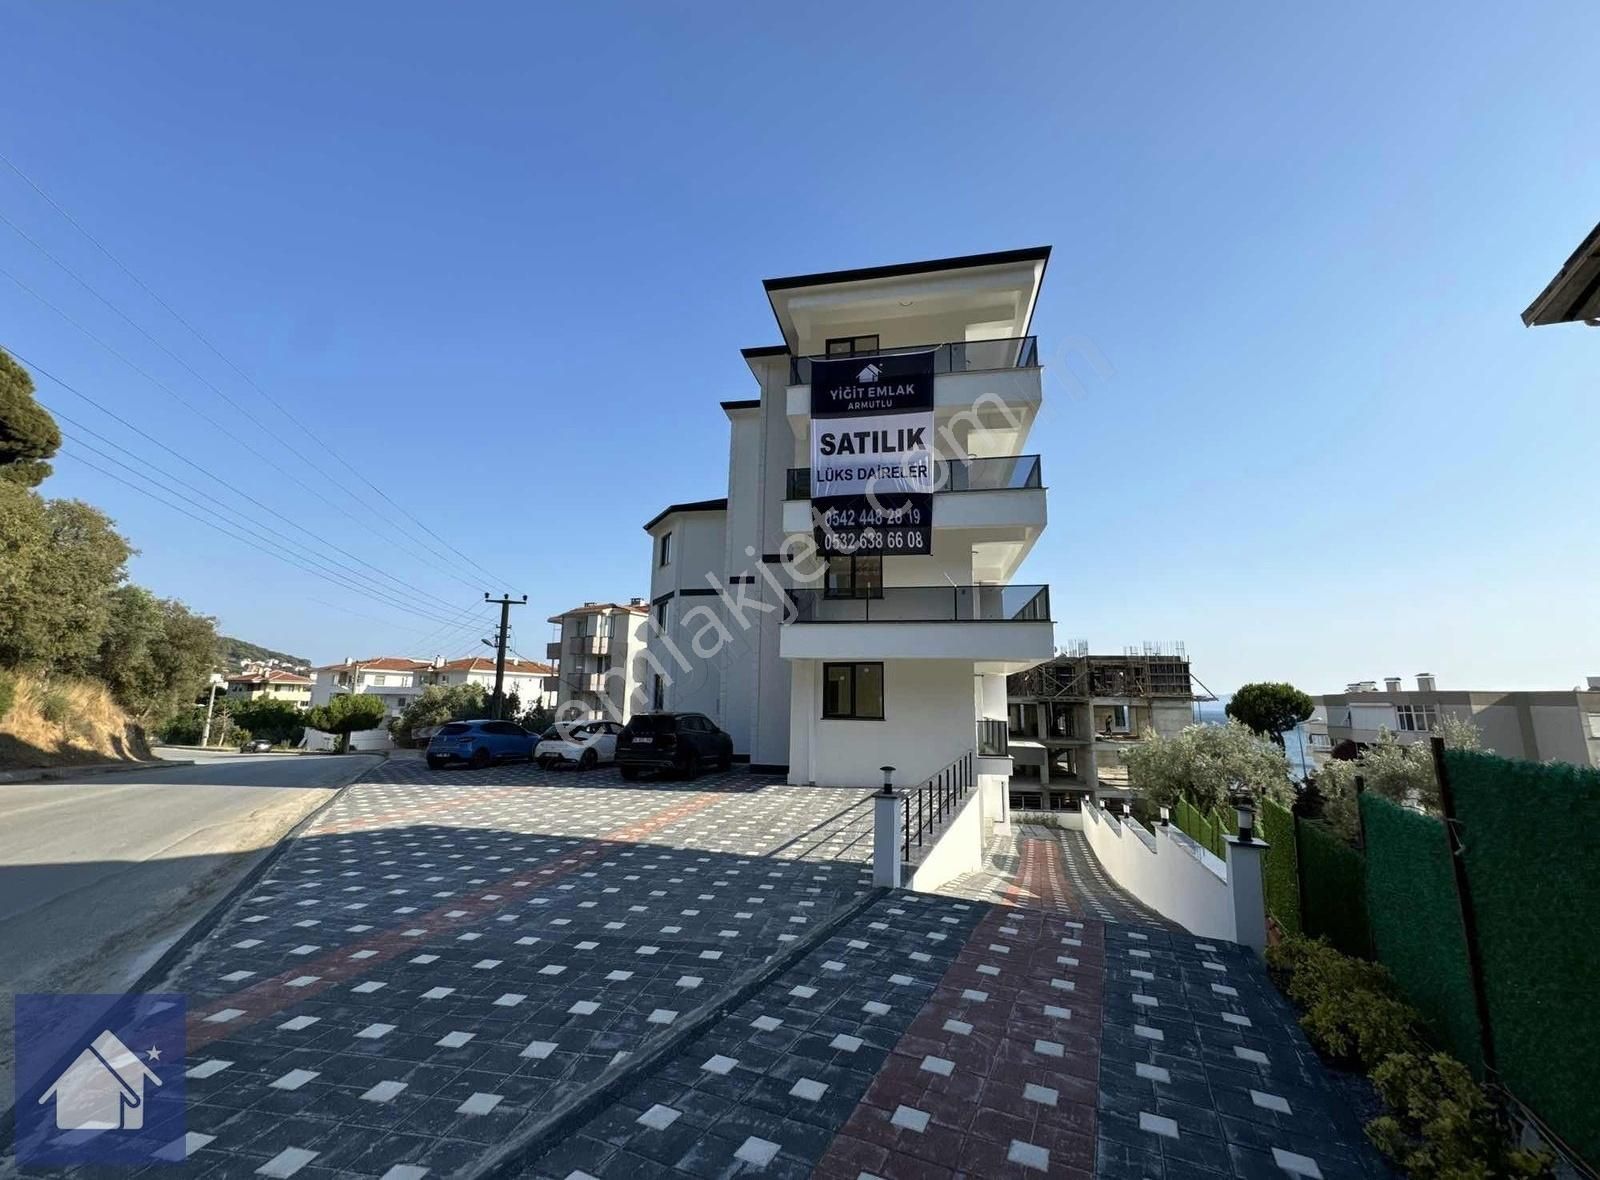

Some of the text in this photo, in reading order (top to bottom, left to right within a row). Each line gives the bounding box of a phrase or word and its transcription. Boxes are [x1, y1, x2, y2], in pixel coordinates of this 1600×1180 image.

[830, 384, 915, 400] YİĞİT EMLAK
[848, 400, 893, 410] ARMUTLU
[820, 426, 926, 456] SATILIK
[816, 464, 928, 483] LÜKS DAİRELER
[824, 508, 921, 527] 0542 448 28 19
[825, 530, 924, 550] 0532 638 66 08
